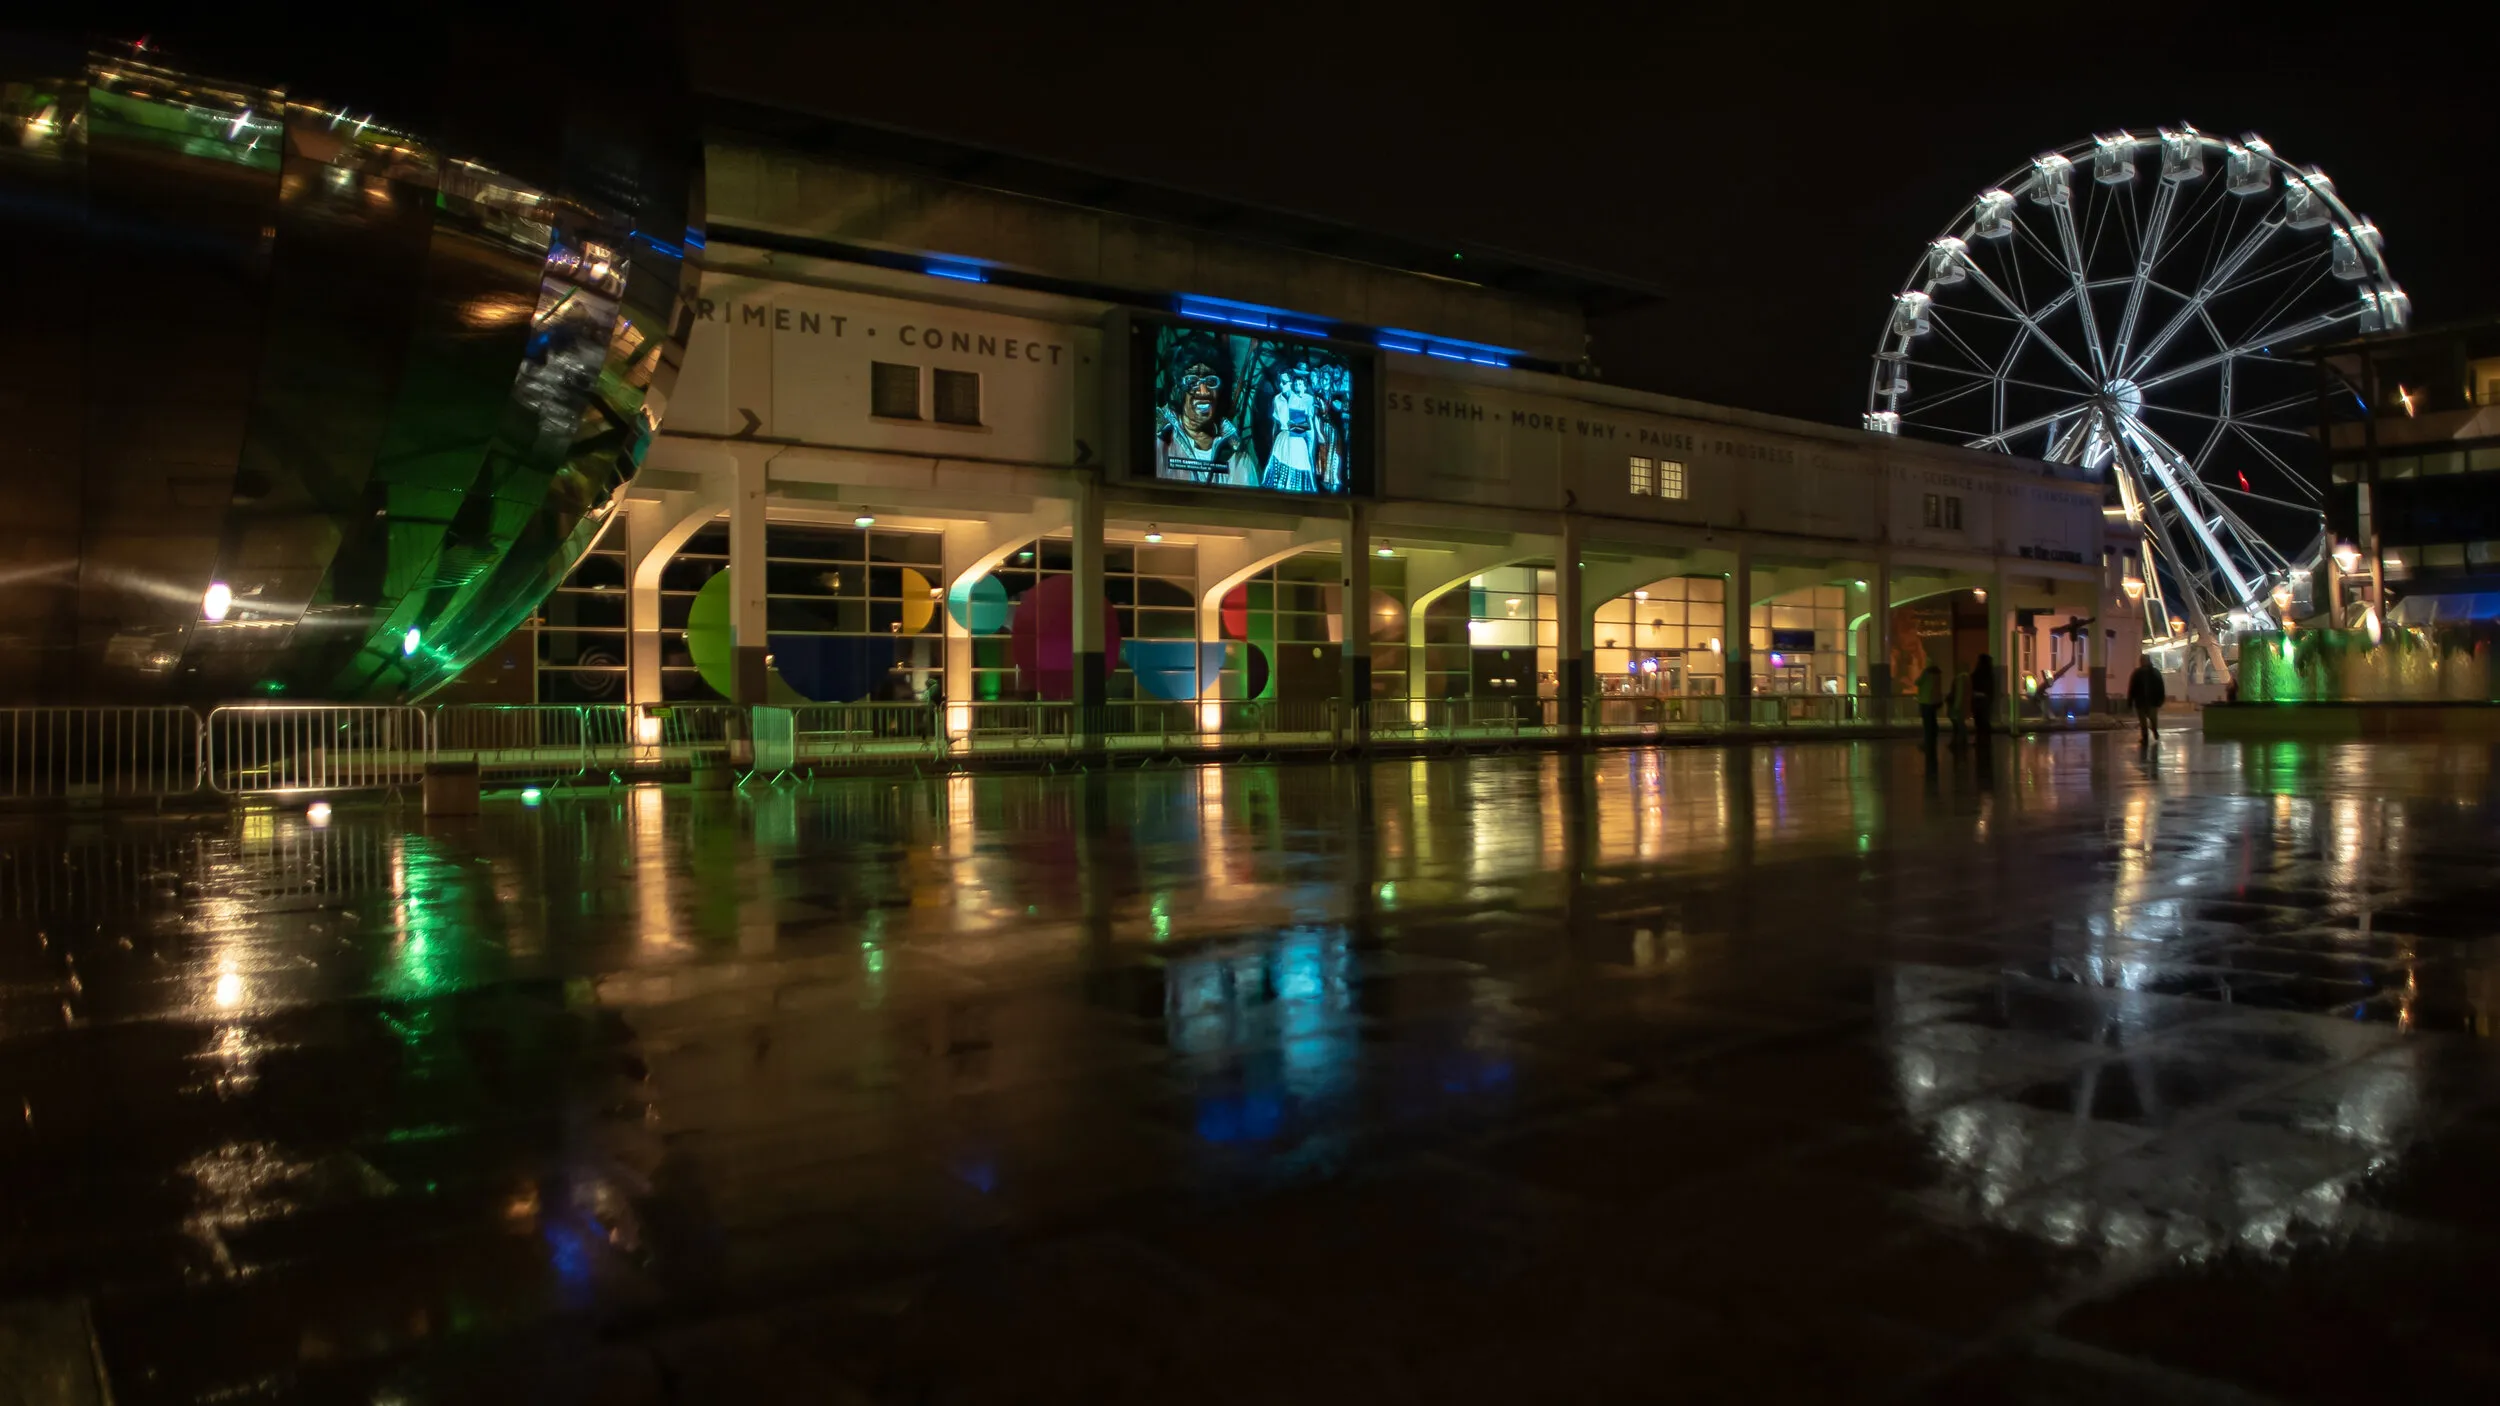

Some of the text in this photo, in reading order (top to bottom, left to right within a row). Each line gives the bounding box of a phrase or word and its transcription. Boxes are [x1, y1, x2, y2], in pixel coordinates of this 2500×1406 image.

[898, 325, 1062, 365] CONNECT
[1388, 392, 1414, 413] SS
[1423, 397, 1483, 423] SHHH
[1511, 410, 1567, 433] MORE
[1576, 420, 1616, 441] WHY
[1640, 428, 1694, 452] PAUSE
[1714, 440, 1794, 464] PROGRESS
[1923, 470, 1973, 491] SCIENCE
